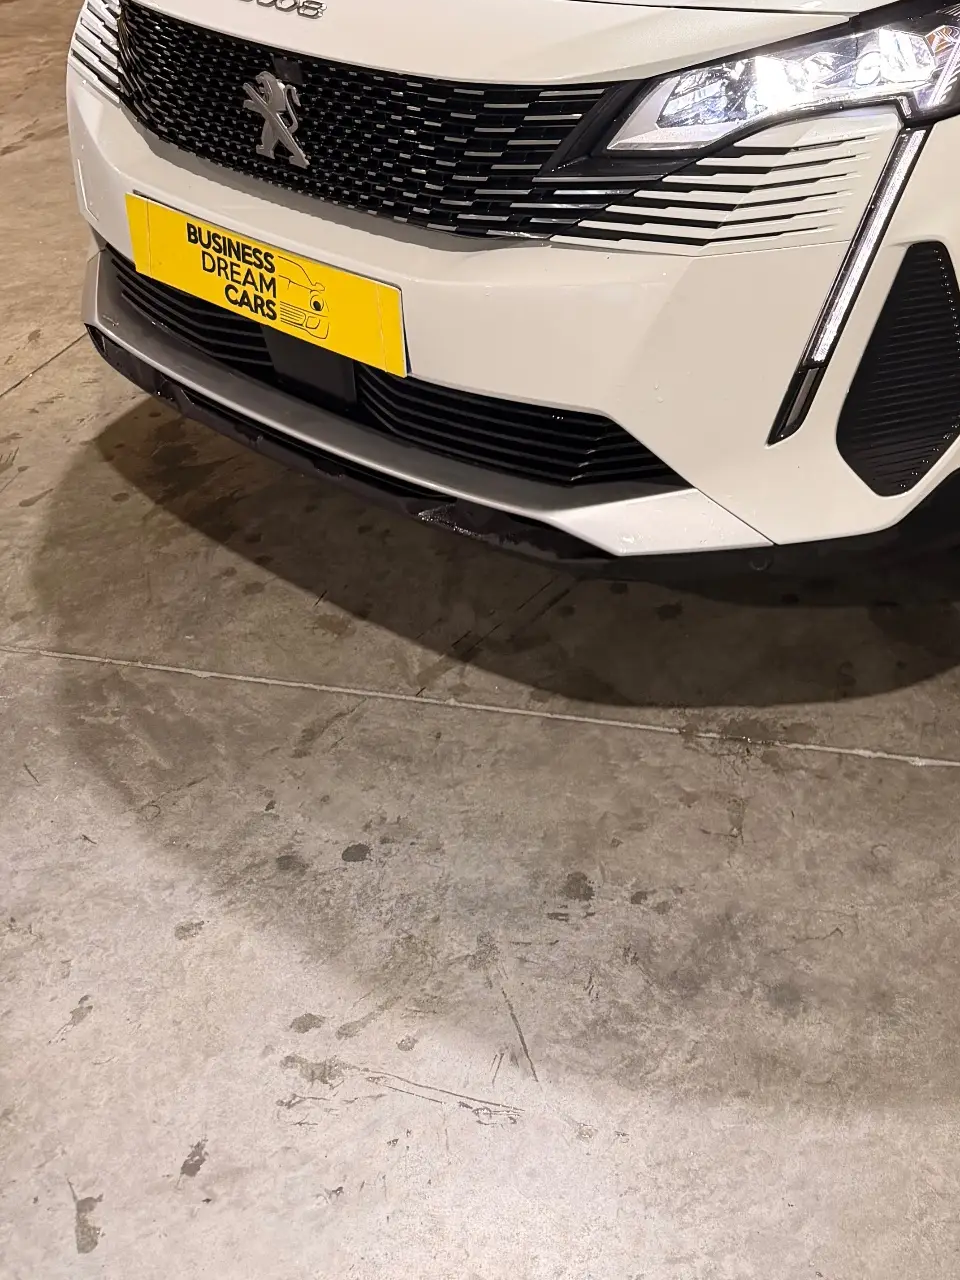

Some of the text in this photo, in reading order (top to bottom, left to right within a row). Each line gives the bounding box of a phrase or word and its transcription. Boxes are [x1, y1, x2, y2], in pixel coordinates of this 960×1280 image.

[187, 222, 276, 273] BUSINESS
[201, 251, 277, 298] DREAM
[224, 284, 277, 321] CARS
